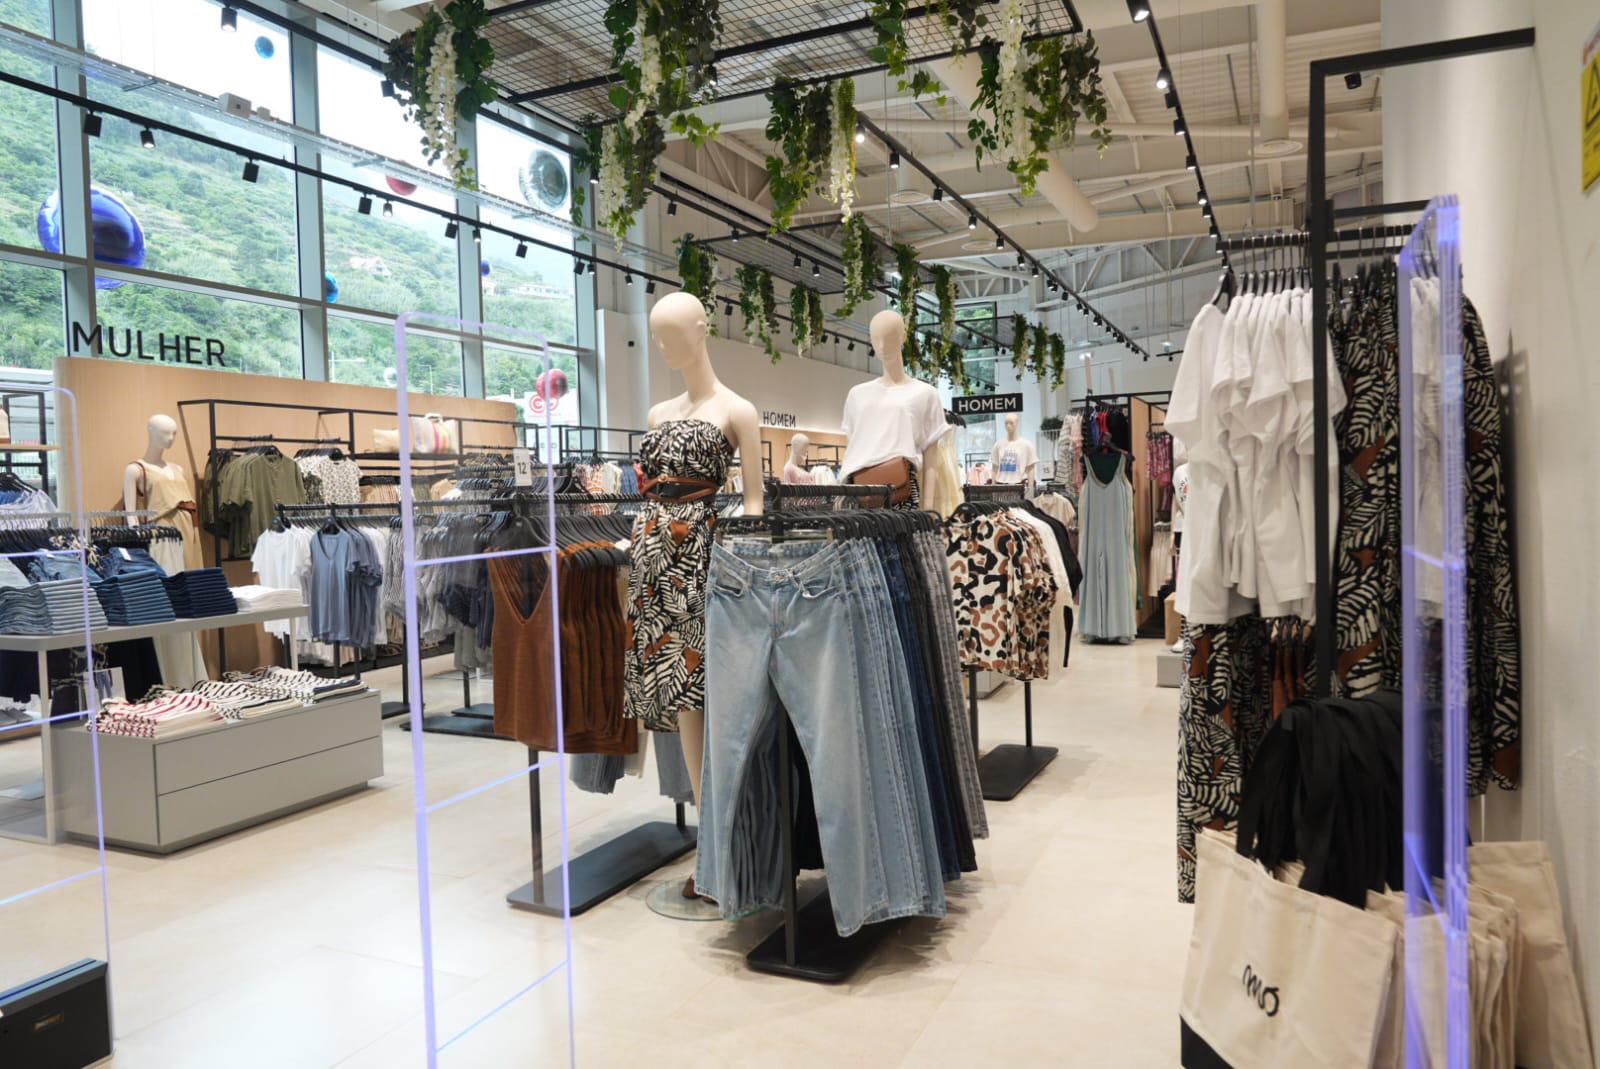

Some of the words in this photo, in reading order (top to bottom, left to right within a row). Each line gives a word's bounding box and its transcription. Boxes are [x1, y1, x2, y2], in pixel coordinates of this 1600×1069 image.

[72, 321, 226, 367] MULHER
[958, 398, 1017, 412] HOMEM
[763, 411, 796, 428] HOMEM
